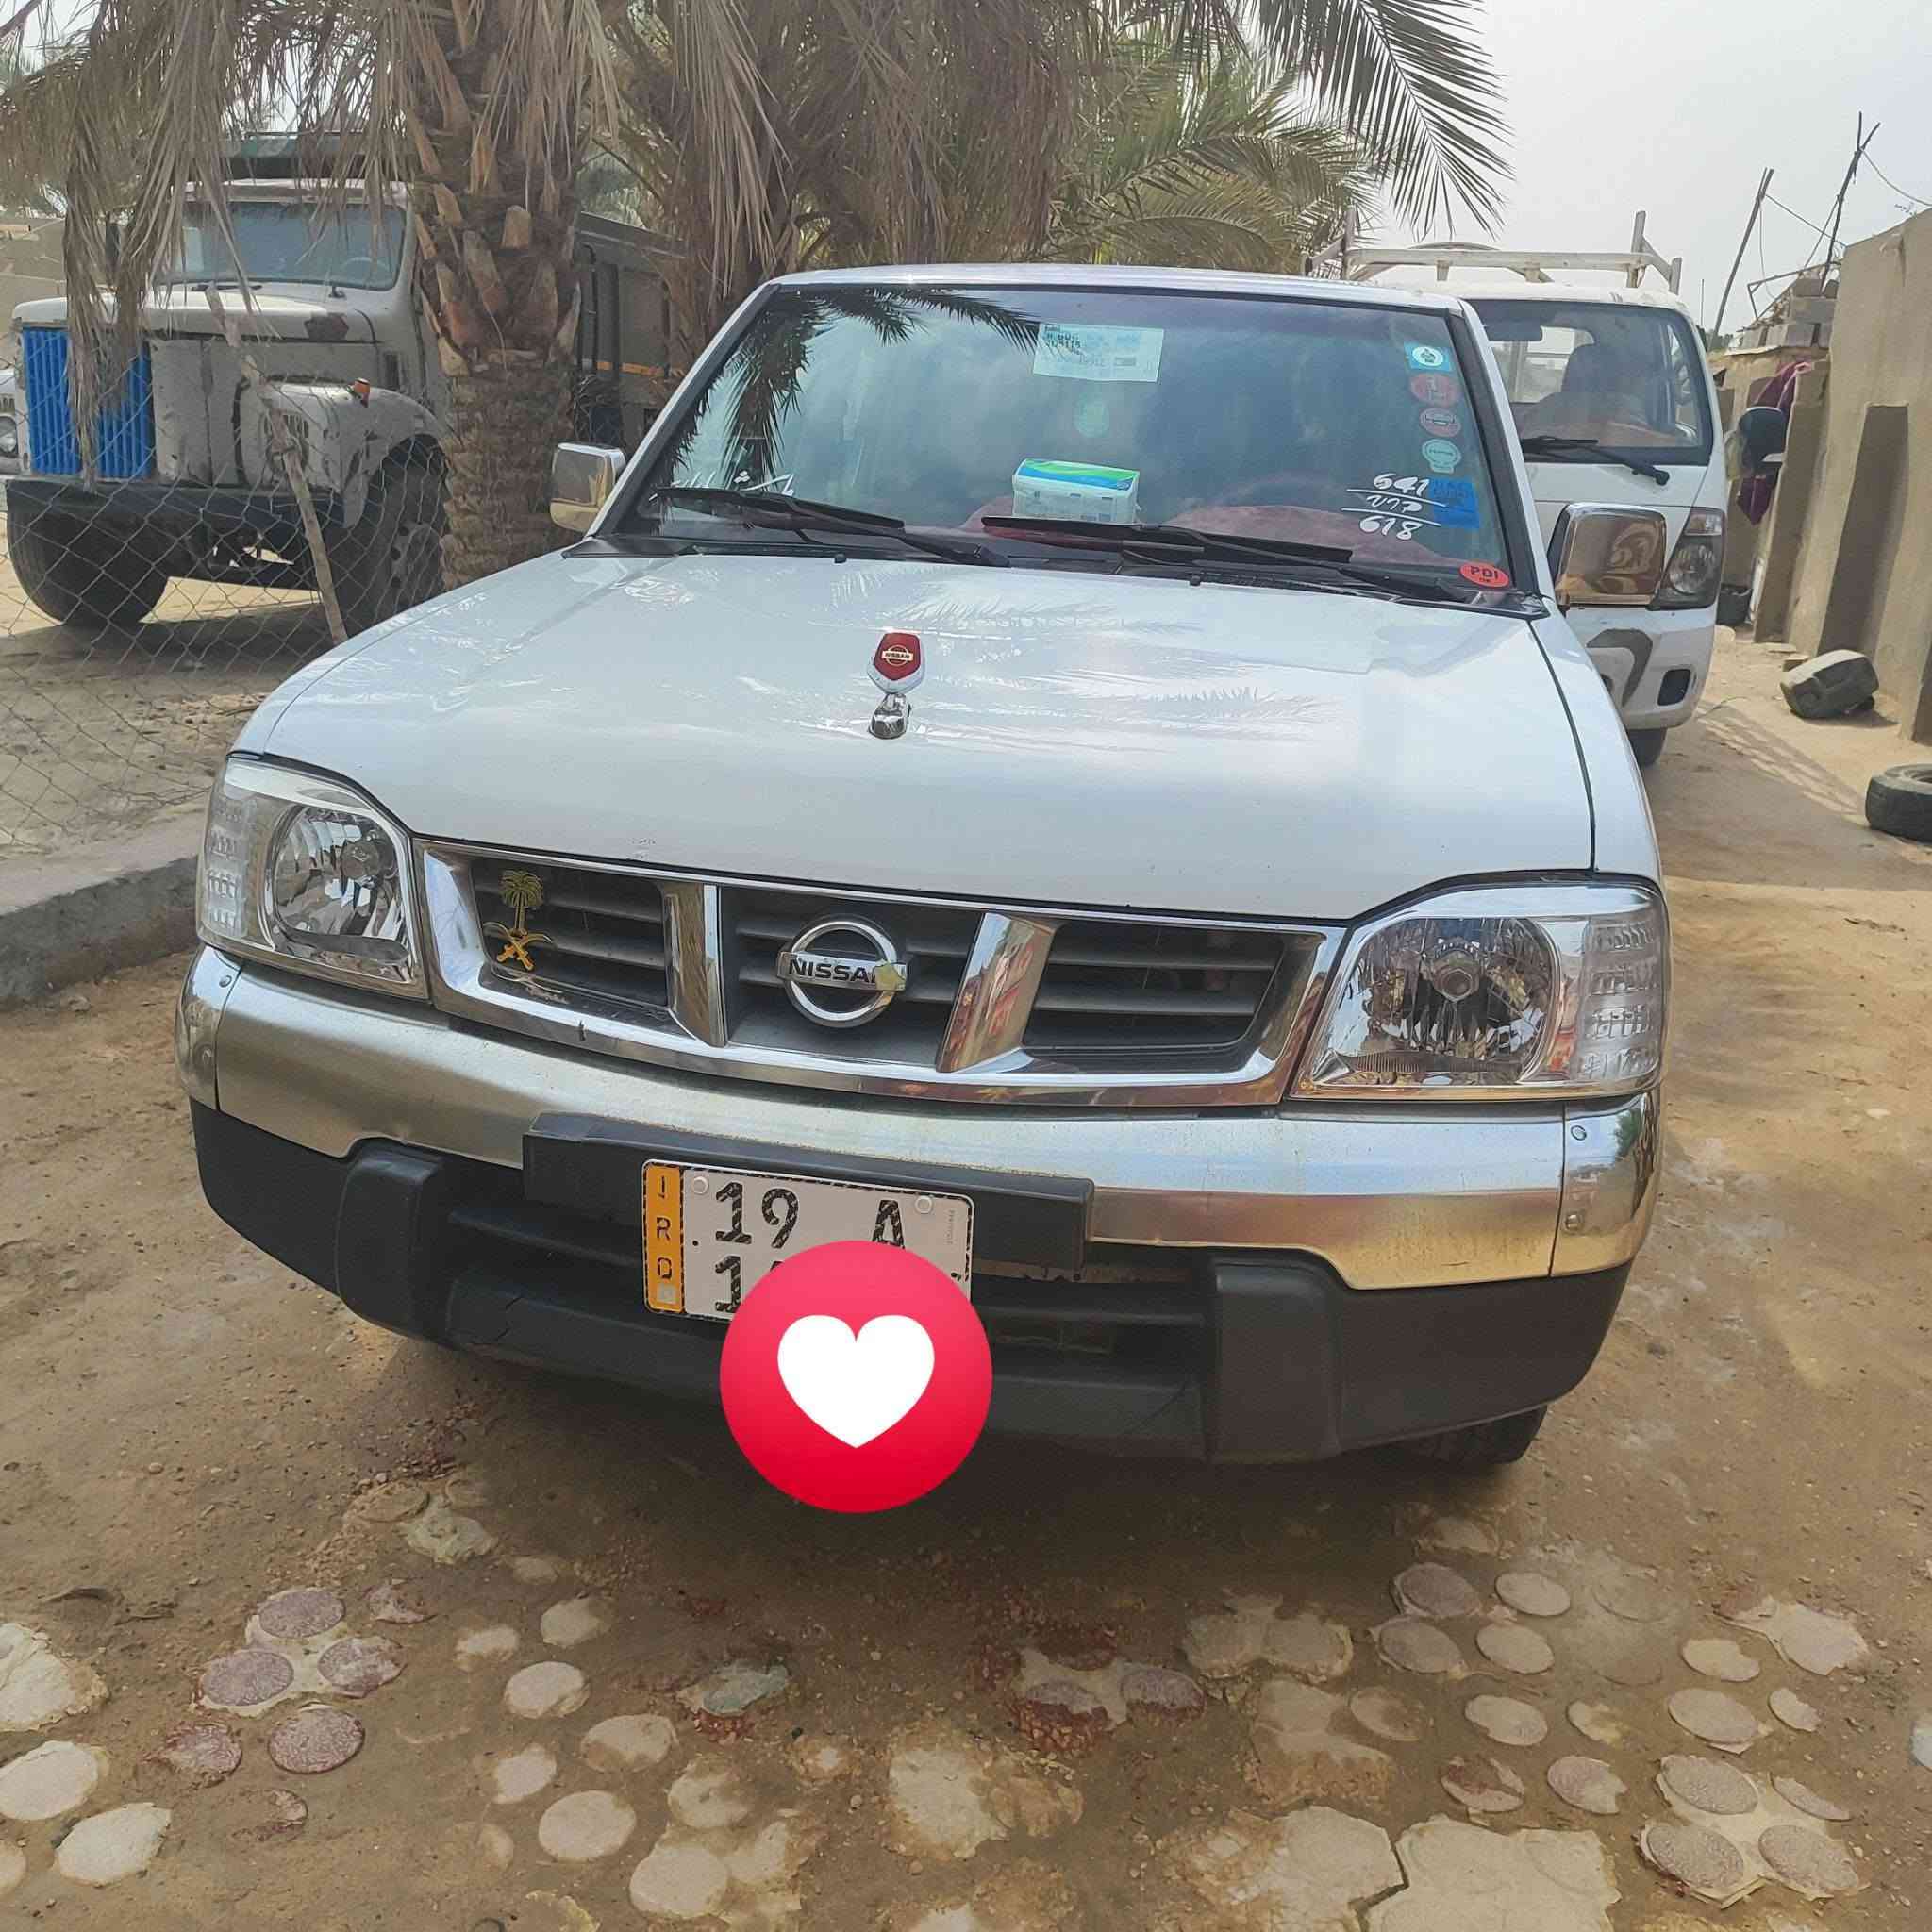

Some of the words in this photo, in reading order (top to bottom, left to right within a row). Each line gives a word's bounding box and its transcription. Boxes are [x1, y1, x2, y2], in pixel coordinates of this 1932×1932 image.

[1359, 515, 1423, 541] 618
[1470, 565, 1499, 580] PDI
[789, 958, 877, 984] NISSA
[716, 1181, 799, 1250] 19
[872, 1199, 906, 1250] A
